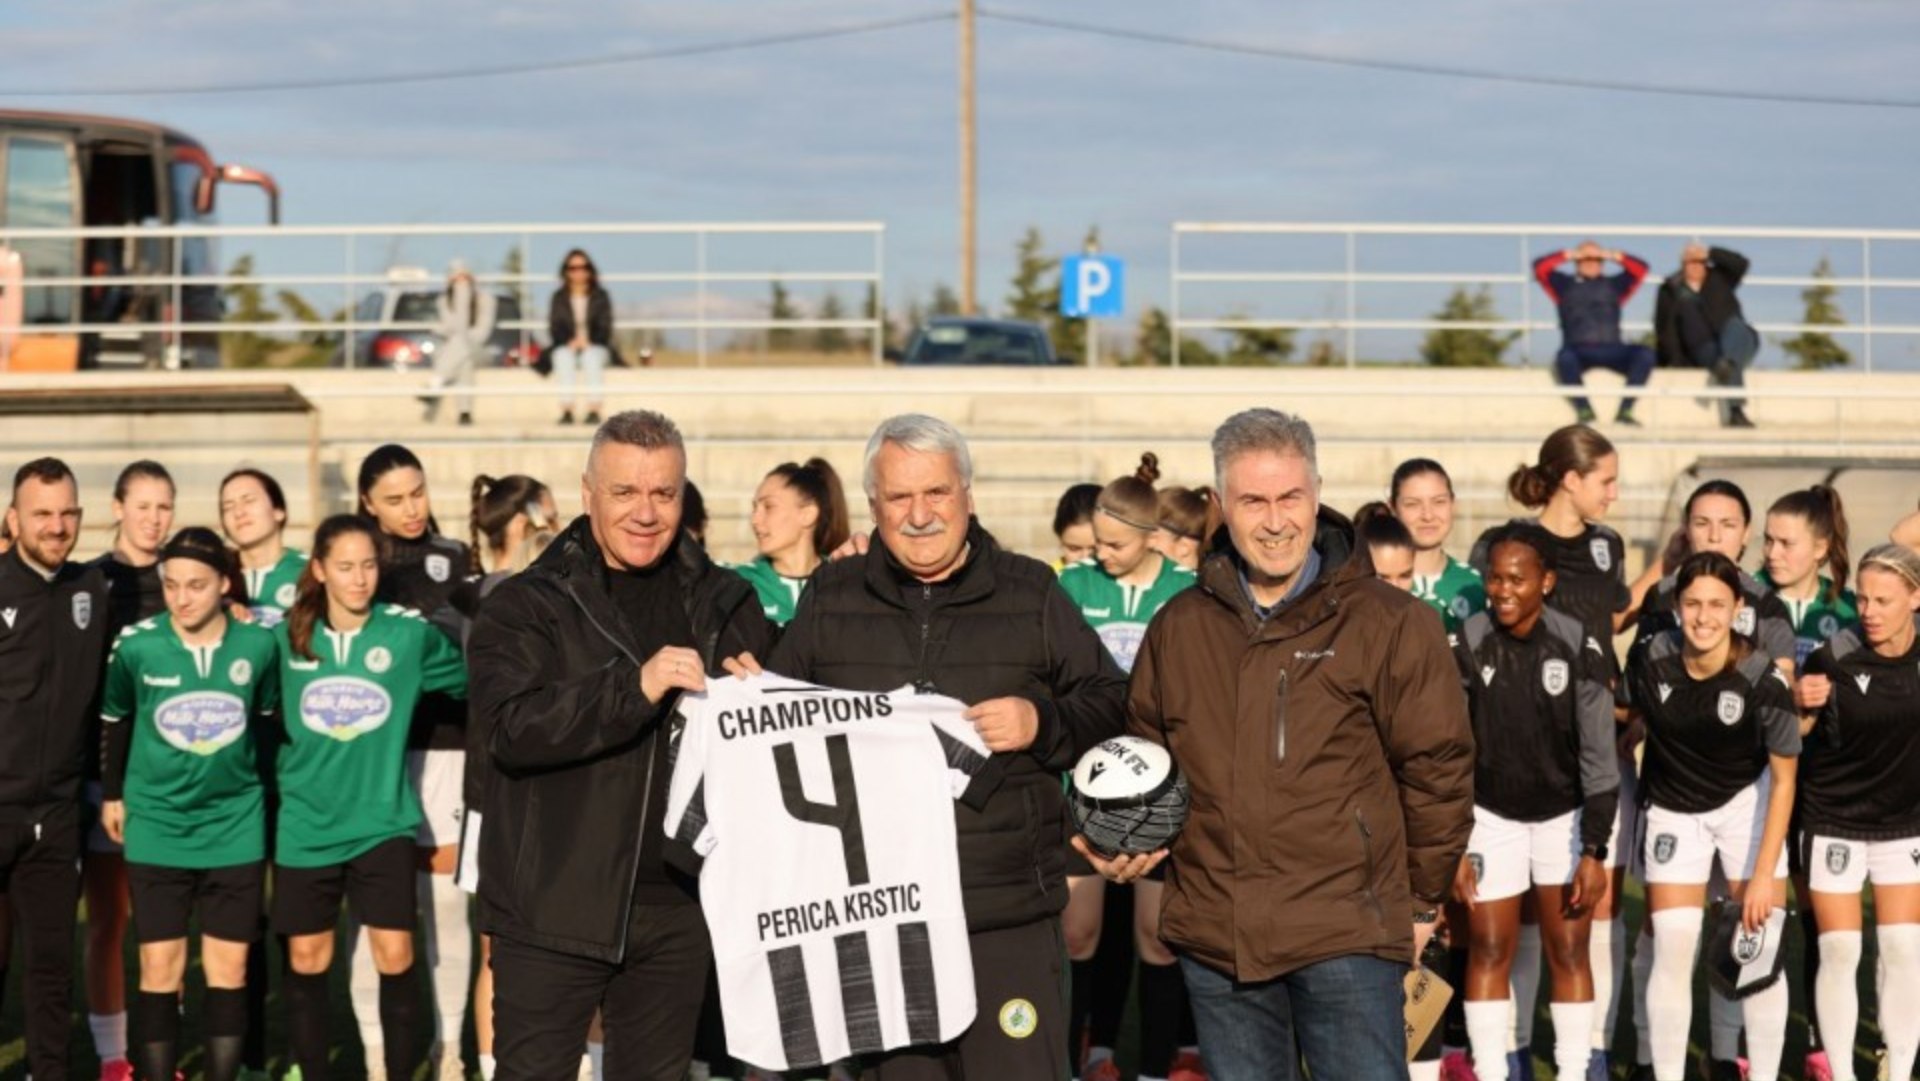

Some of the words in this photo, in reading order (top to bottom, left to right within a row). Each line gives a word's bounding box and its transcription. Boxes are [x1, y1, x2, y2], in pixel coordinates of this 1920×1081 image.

[1077, 260, 1112, 313] P
[718, 691, 894, 741] CHAMPIONS
[771, 733, 870, 887] 4
[757, 900, 840, 941] PERICA
[843, 883, 922, 924] KRSTIC
